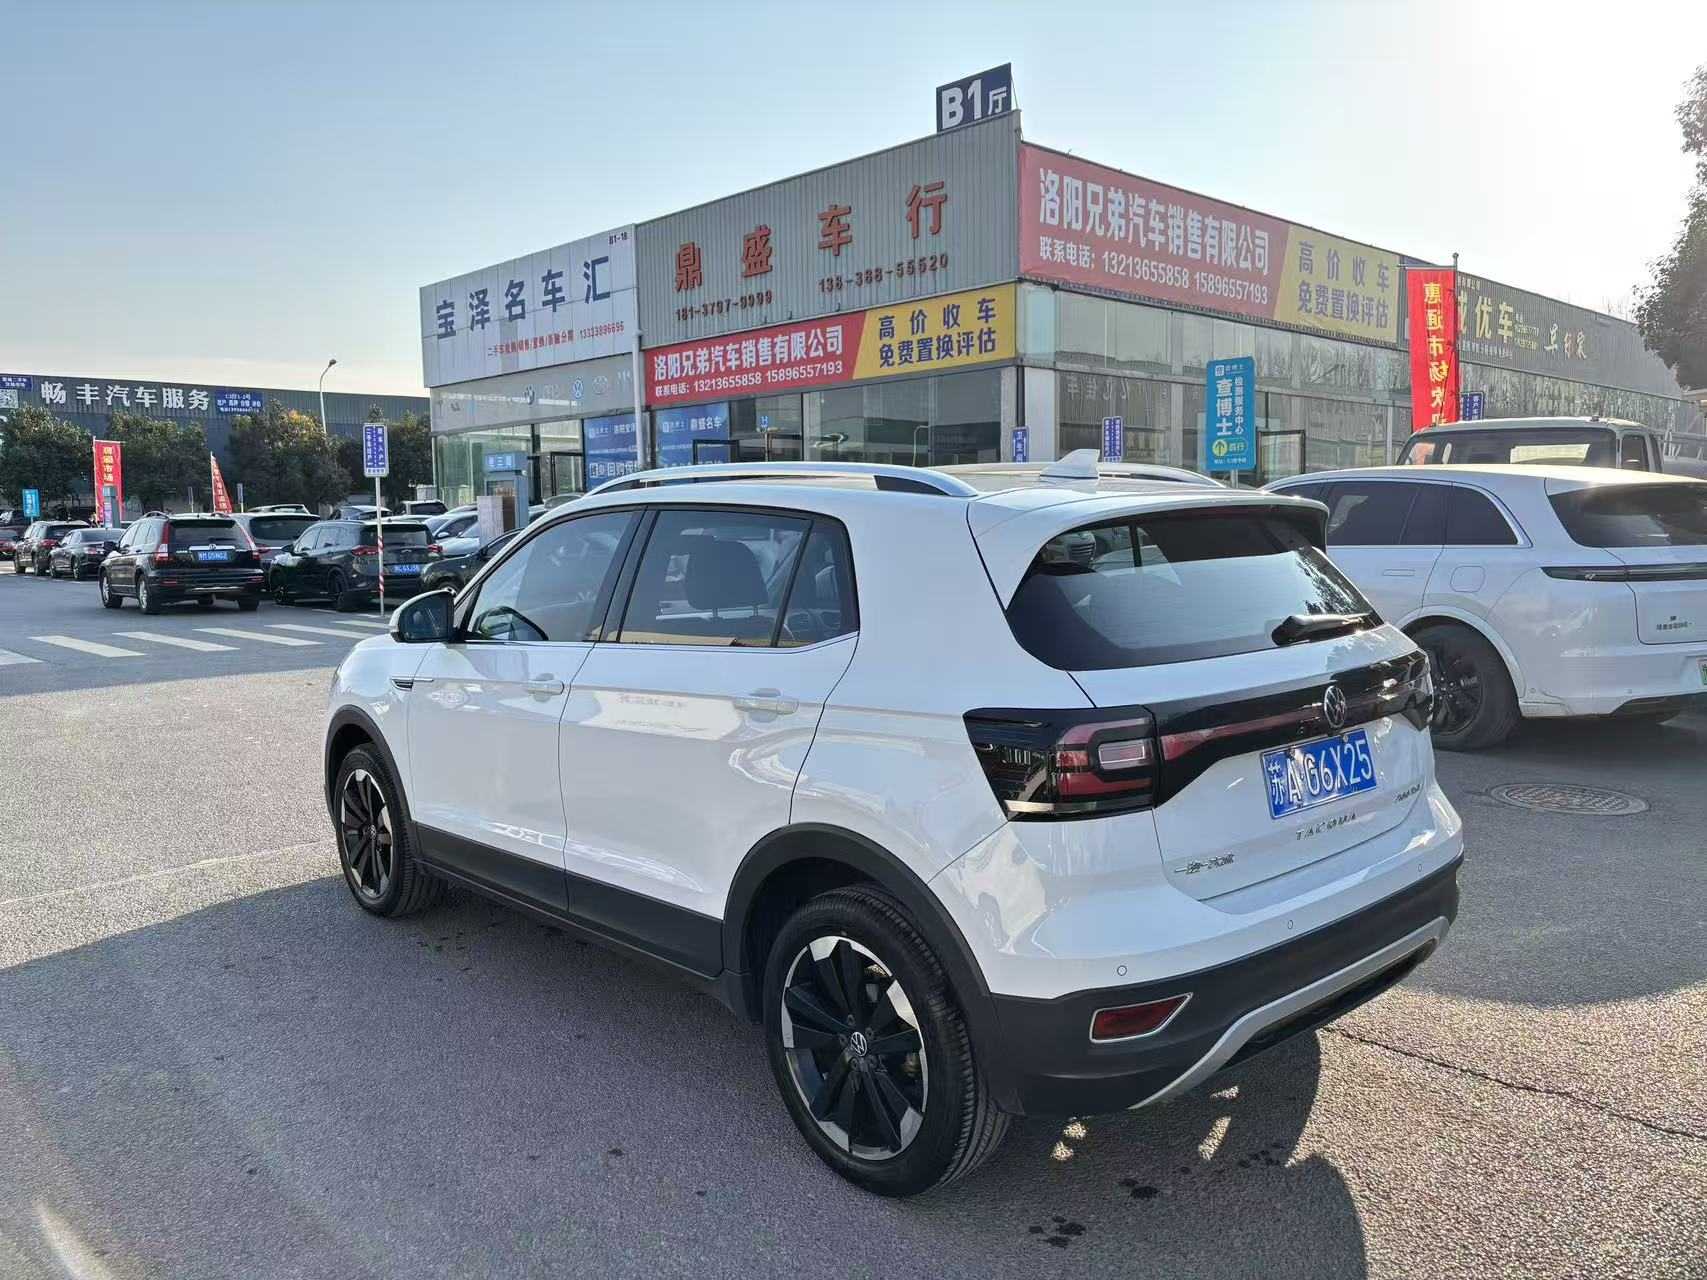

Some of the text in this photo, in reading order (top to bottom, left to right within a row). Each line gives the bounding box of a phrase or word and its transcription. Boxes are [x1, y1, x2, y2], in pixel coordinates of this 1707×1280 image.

[941, 79, 1008, 130] B1厅
[675, 181, 948, 293] 鼎盛车行
[1039, 167, 1270, 276] 洛阳兄弟汽车销售有限公司
[1101, 250, 1190, 289] 13213655858
[1193, 271, 1269, 305] 15896557193
[1298, 240, 1391, 293] 高价收车
[435, 255, 611, 340] 宝泽名车汇
[878, 298, 997, 341] 高价收车
[1297, 280, 1390, 329] 免费置换评估
[653, 325, 843, 381] 洛阳兄弟汽车销售有限公司
[878, 328, 997, 369] 免费置换评估
[41, 380, 209, 411] 畅丰汽车服务
[693, 372, 762, 394] 13213655858
[766, 360, 843, 384] 15896557193
[1216, 379, 1232, 435] 查博士
